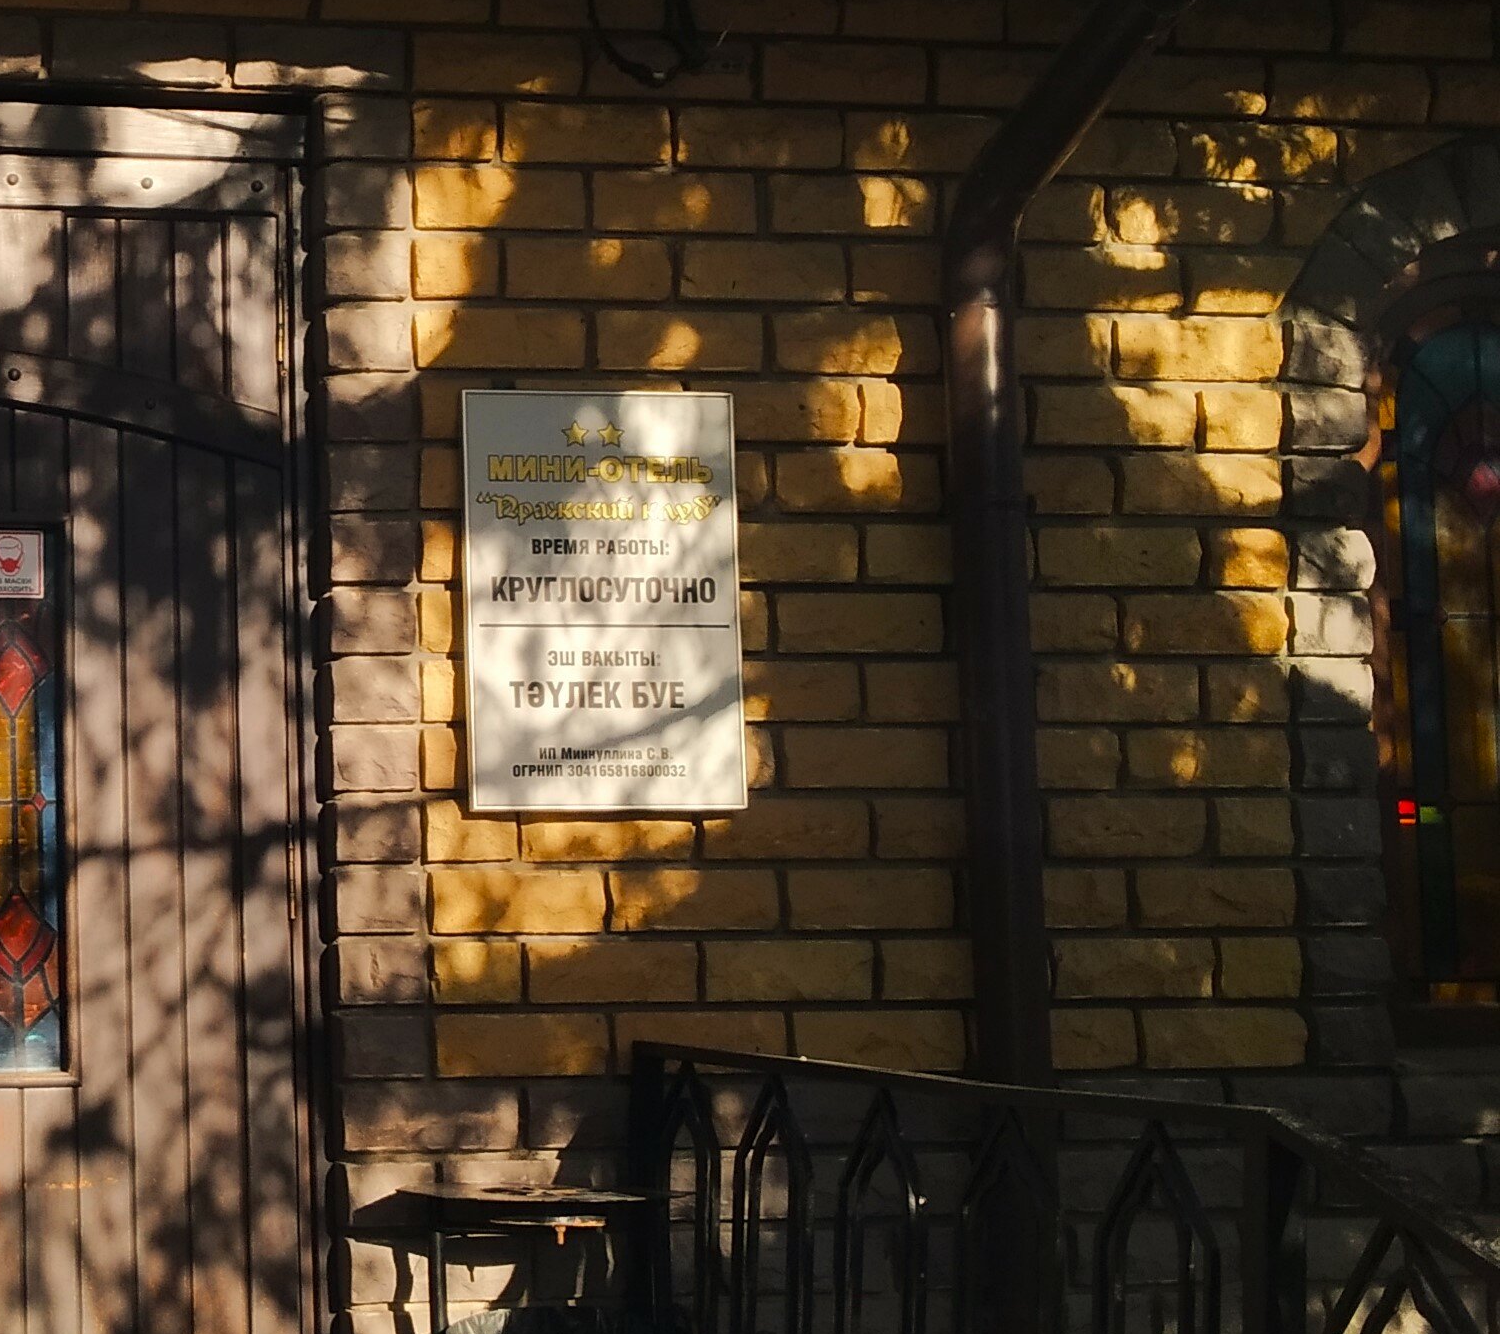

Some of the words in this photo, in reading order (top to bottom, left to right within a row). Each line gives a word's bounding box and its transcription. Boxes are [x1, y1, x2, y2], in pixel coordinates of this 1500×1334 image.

[487, 455, 713, 483] МИНИ-ОТЕЛЬ
[532, 538, 589, 555] ВРЕМЯ
[596, 539, 670, 555] РАБОТЫ:
[491, 576, 716, 603] КРУГЛОСУТОЧНО
[548, 651, 575, 666] ЭШ
[582, 651, 661, 667] ВАКЫТЫ:
[632, 681, 685, 708] БУЕ
[540, 748, 556, 759] ИП
[561, 748, 642, 762] Миннуллина
[513, 765, 563, 776] ОГРНИП
[568, 765, 686, 777] 304165816800032
